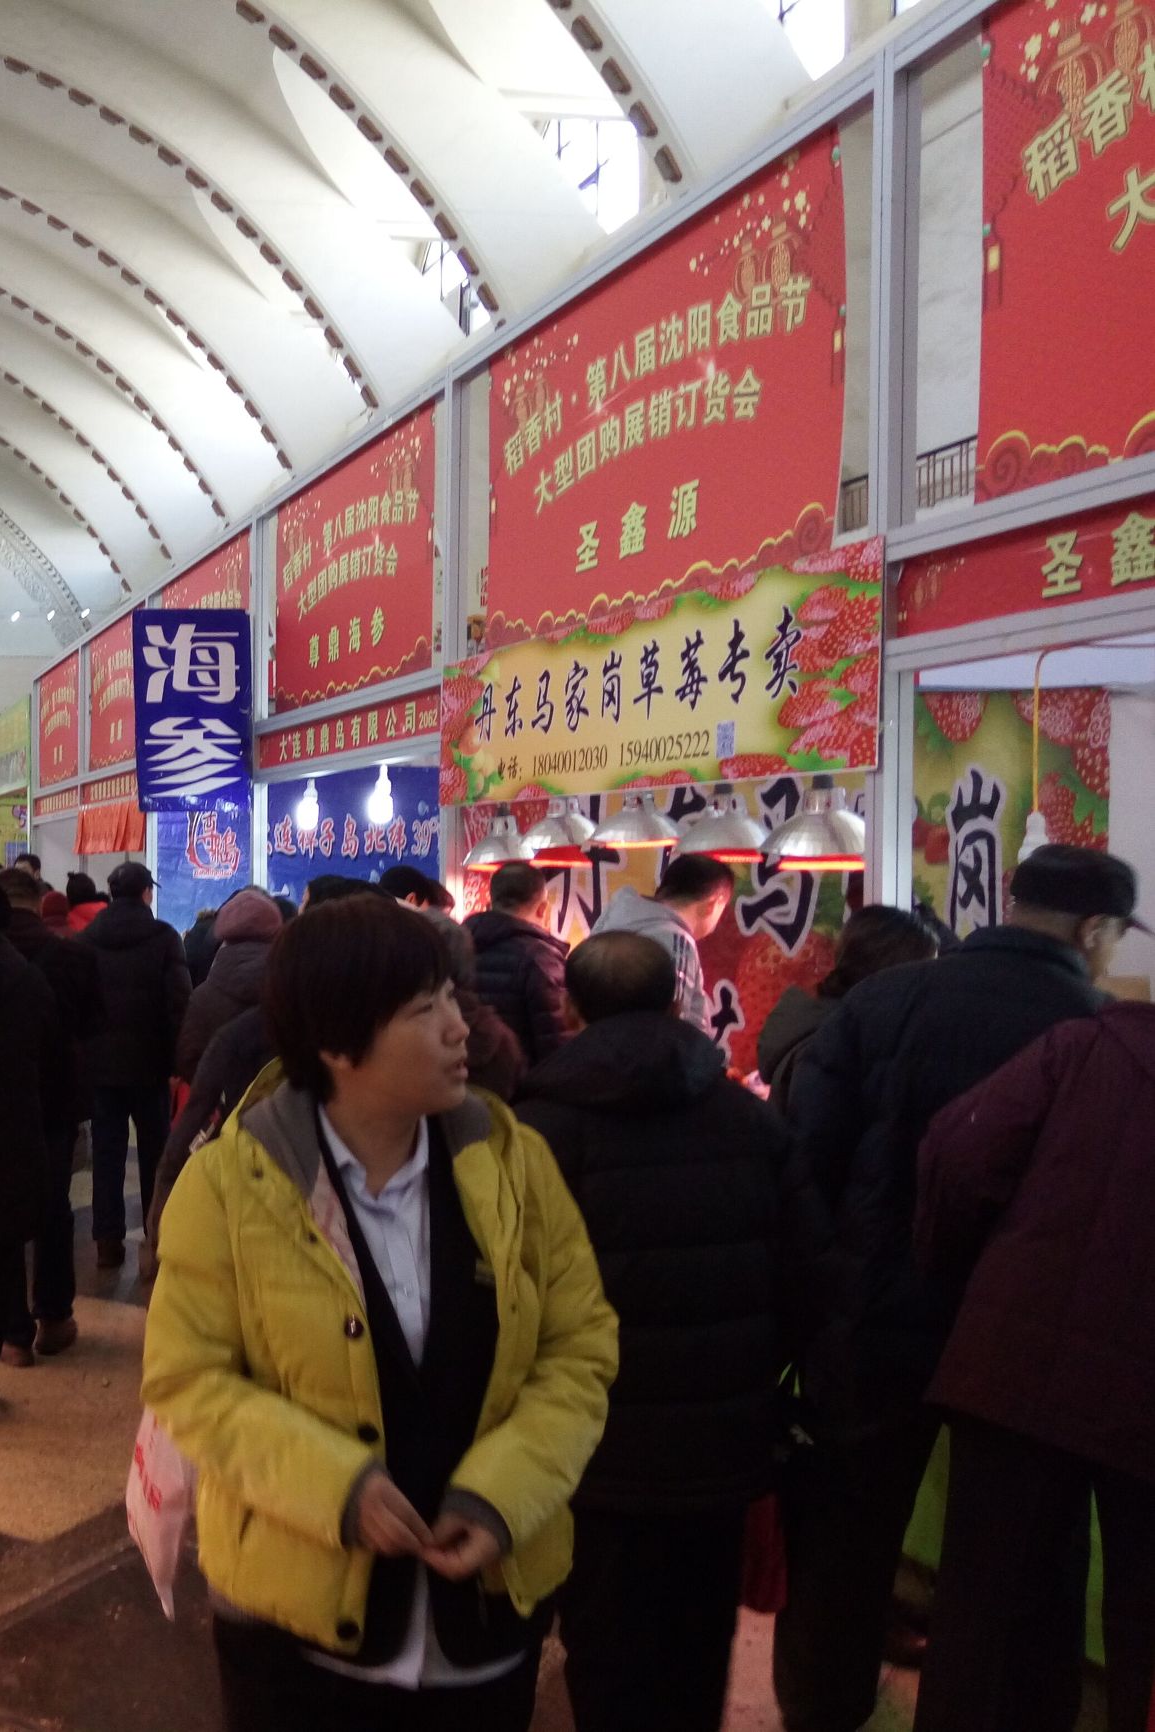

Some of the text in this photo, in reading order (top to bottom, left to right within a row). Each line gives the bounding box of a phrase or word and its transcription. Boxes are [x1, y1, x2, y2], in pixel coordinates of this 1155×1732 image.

[534, 367, 762, 515] 大型团购展销订货会
[575, 479, 700, 573] 圣鑫源
[142, 623, 241, 798] 海参
[474, 605, 803, 743] 丹东马家岗草莓专卖
[532, 745, 609, 778] 18040012030
[619, 730, 711, 767] 15940025222
